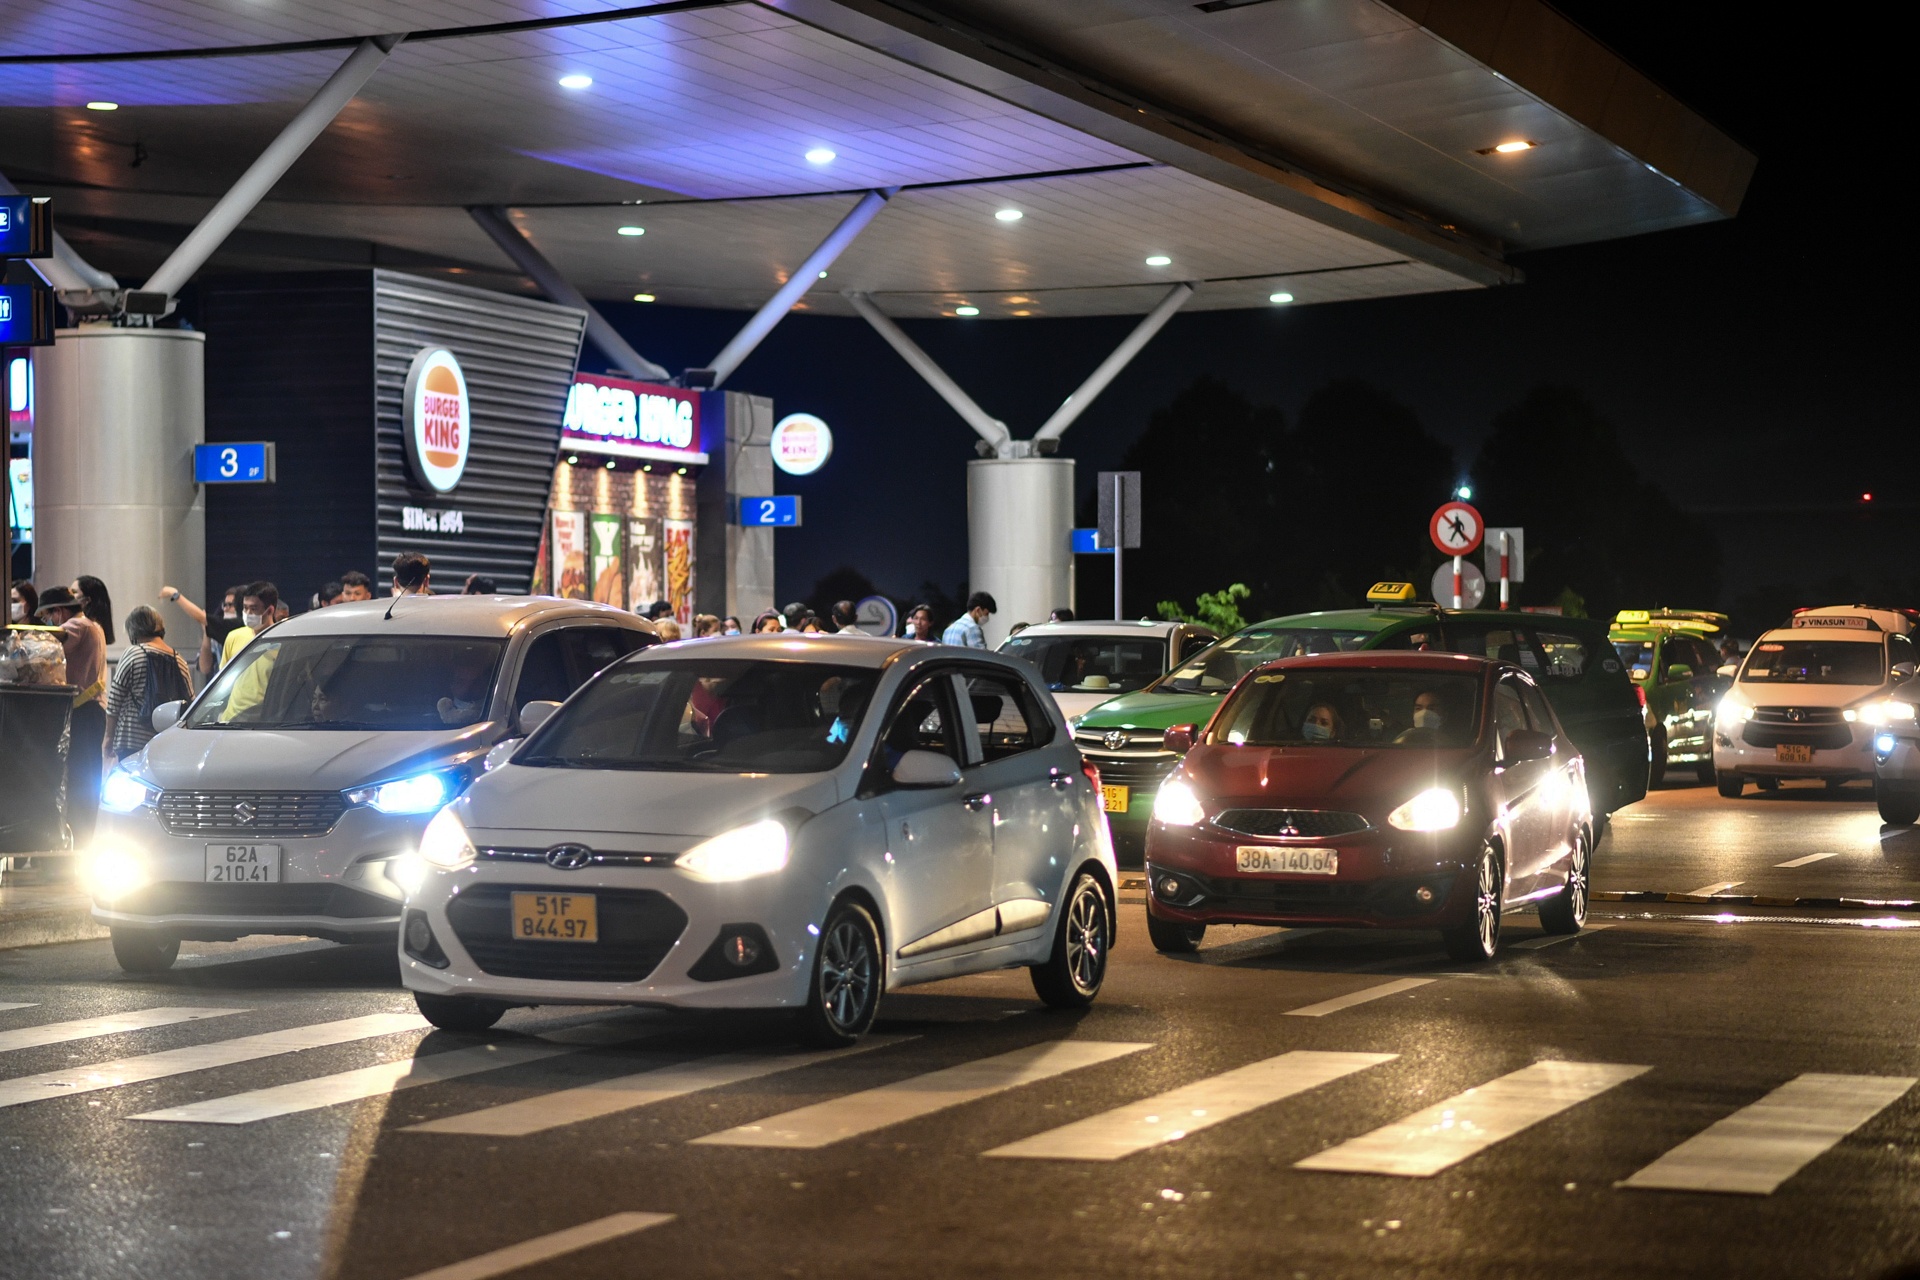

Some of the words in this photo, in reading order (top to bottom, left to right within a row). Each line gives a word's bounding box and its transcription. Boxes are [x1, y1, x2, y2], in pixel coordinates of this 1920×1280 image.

[424, 396, 460, 419] BURGER
[424, 418, 460, 450] KING
[220, 447, 239, 478] 3
[760, 500, 776, 523] 2
[1090, 531, 1099, 551] 1
[1808, 618, 1846, 626] VINASUN
[1848, 619, 1864, 627] TAXI
[1101, 787, 1117, 798] 51G
[226, 846, 258, 863] 62A
[213, 865, 268, 882] 210.41
[536, 896, 572, 916] 51F
[522, 917, 588, 939] 844.97
